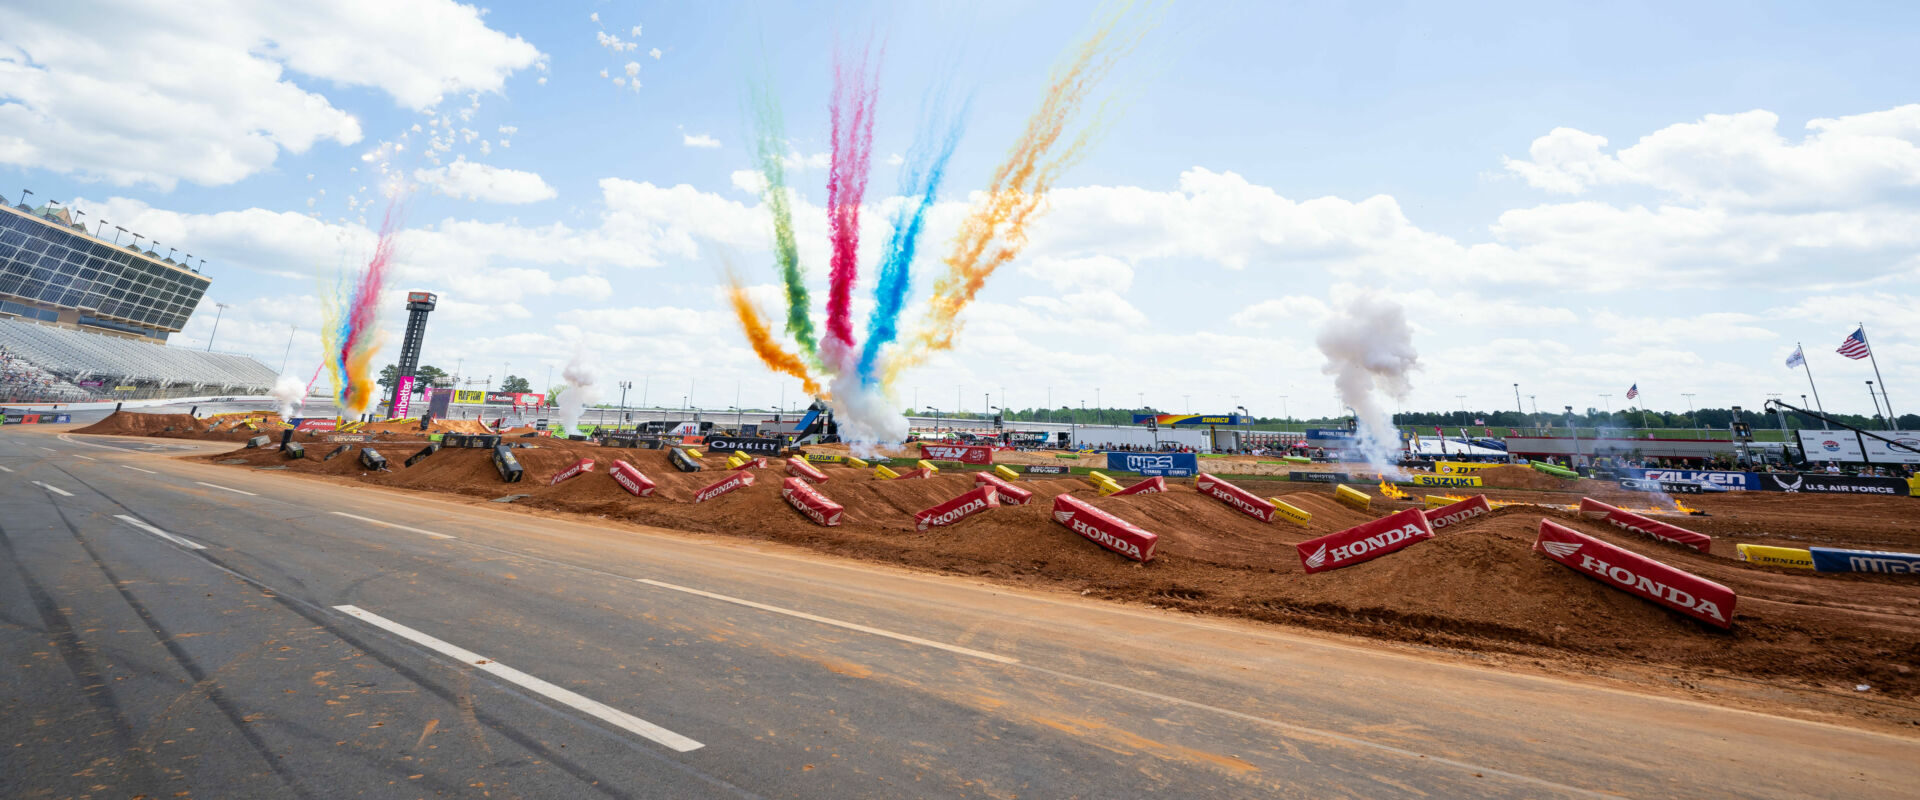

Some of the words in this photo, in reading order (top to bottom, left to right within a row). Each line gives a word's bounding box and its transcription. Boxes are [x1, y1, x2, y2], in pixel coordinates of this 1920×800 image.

[397, 379, 412, 419] mbetter
[458, 390, 481, 401] RAPTOR
[728, 442, 777, 450] OAKLEY
[925, 446, 968, 458] FLY
[1127, 456, 1173, 471] WPS
[614, 472, 640, 494] HONDA
[1422, 476, 1474, 486] SUZUKI
[1645, 470, 1745, 484] FALKEN
[704, 478, 740, 500] HONDA
[1642, 482, 1698, 492] OAKLEY
[1852, 486, 1895, 494] FORCE
[790, 494, 824, 524] HONDA
[1212, 488, 1266, 519] HONDA
[932, 498, 987, 526] HONDA
[1276, 506, 1306, 520] DUNLOP
[1072, 518, 1142, 558] HONDA
[1329, 523, 1426, 563] HONDA
[1762, 556, 1813, 566] DUNLOP
[1580, 553, 1726, 622] HONDA
